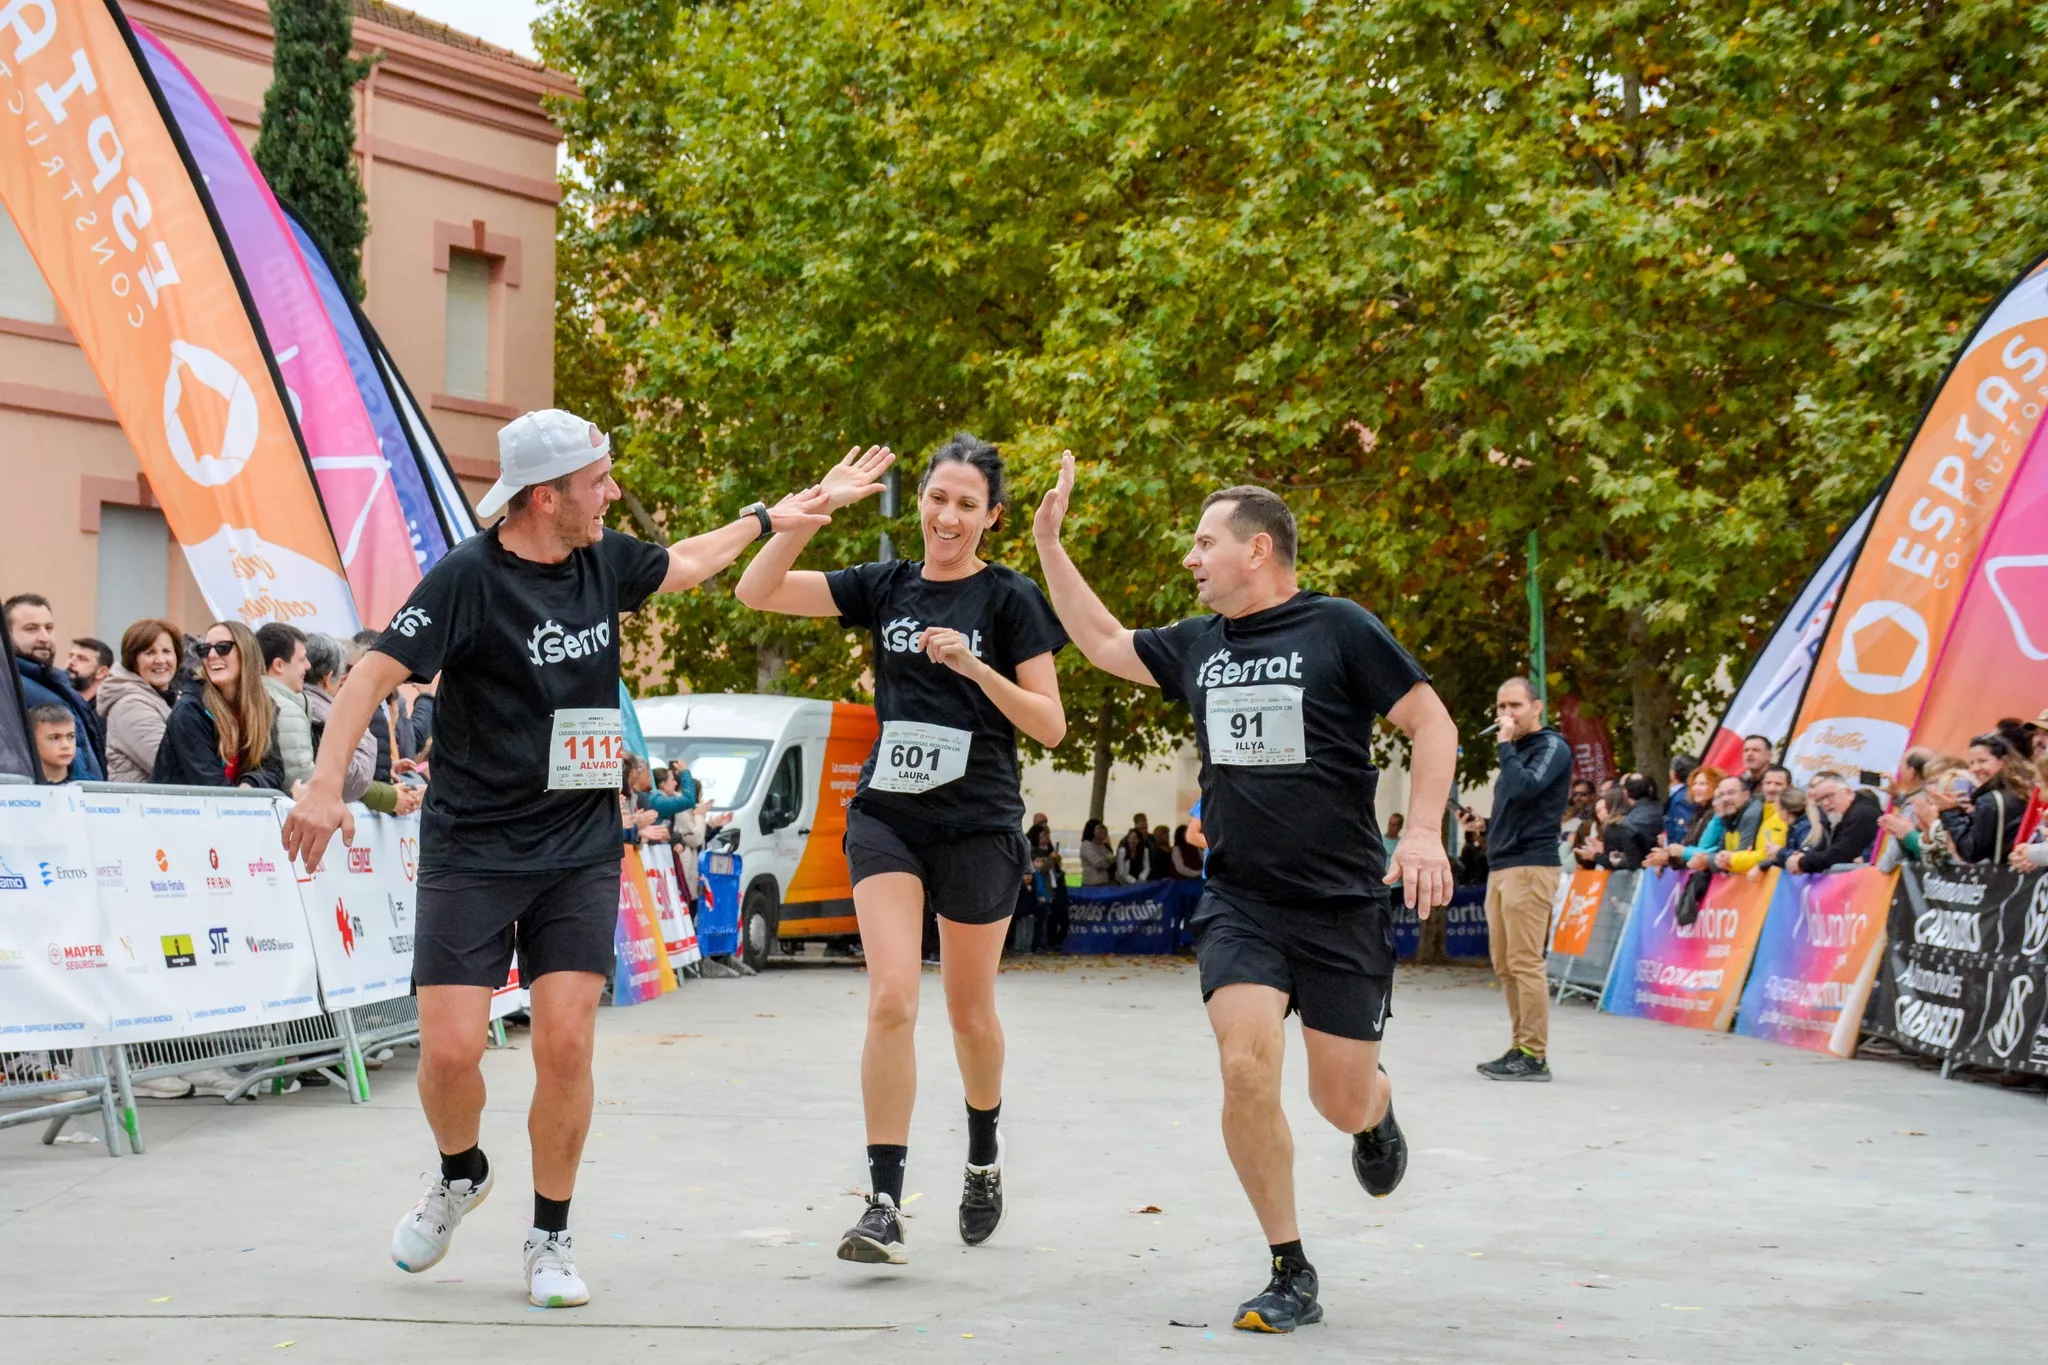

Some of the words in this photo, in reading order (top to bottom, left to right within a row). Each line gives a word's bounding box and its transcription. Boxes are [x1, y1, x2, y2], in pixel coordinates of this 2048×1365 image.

[1888, 334, 2047, 580] ESPIAS
[543, 616, 611, 663] serra
[1230, 712, 1263, 738] 91
[564, 736, 622, 760] 1112
[890, 744, 940, 771] 601
[1236, 742, 1264, 750] ILLYA
[580, 761, 618, 770] ALVARO
[898, 770, 930, 780] LAURA
[56, 866, 87, 880] Ercros
[209, 927, 229, 954] STF
[66, 960, 95, 970] SEGUROS
